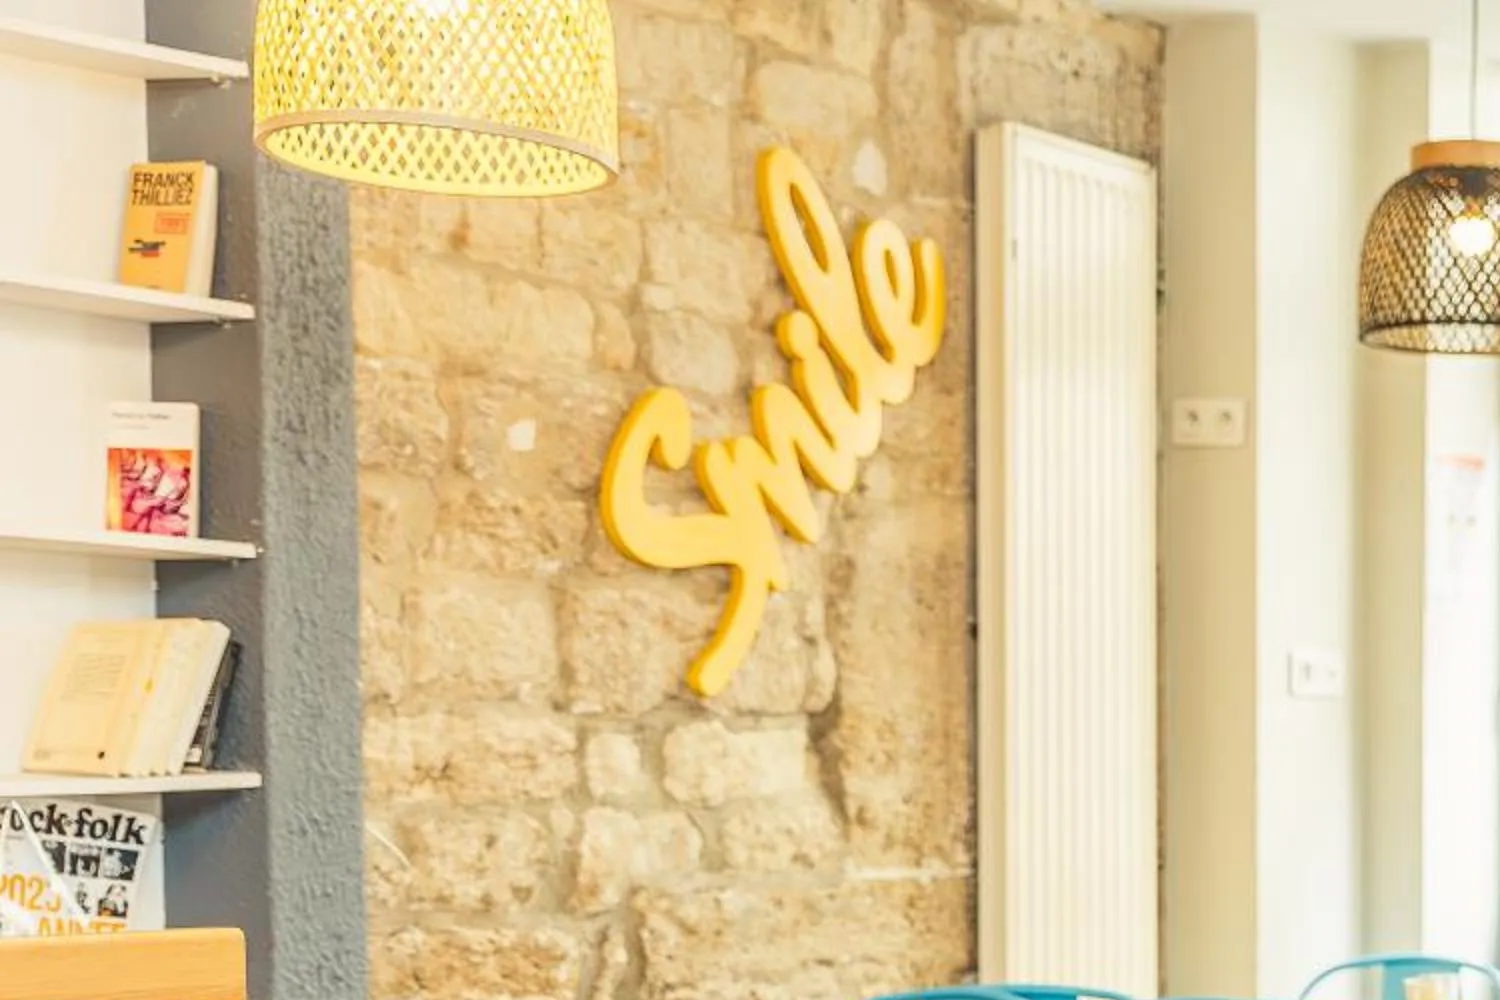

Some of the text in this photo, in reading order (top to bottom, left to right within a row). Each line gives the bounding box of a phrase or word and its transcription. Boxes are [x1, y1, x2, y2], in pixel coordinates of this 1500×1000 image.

[132, 171, 195, 189] FRANCK
[599, 146, 946, 697] Smile
[74, 807, 147, 845] folk
